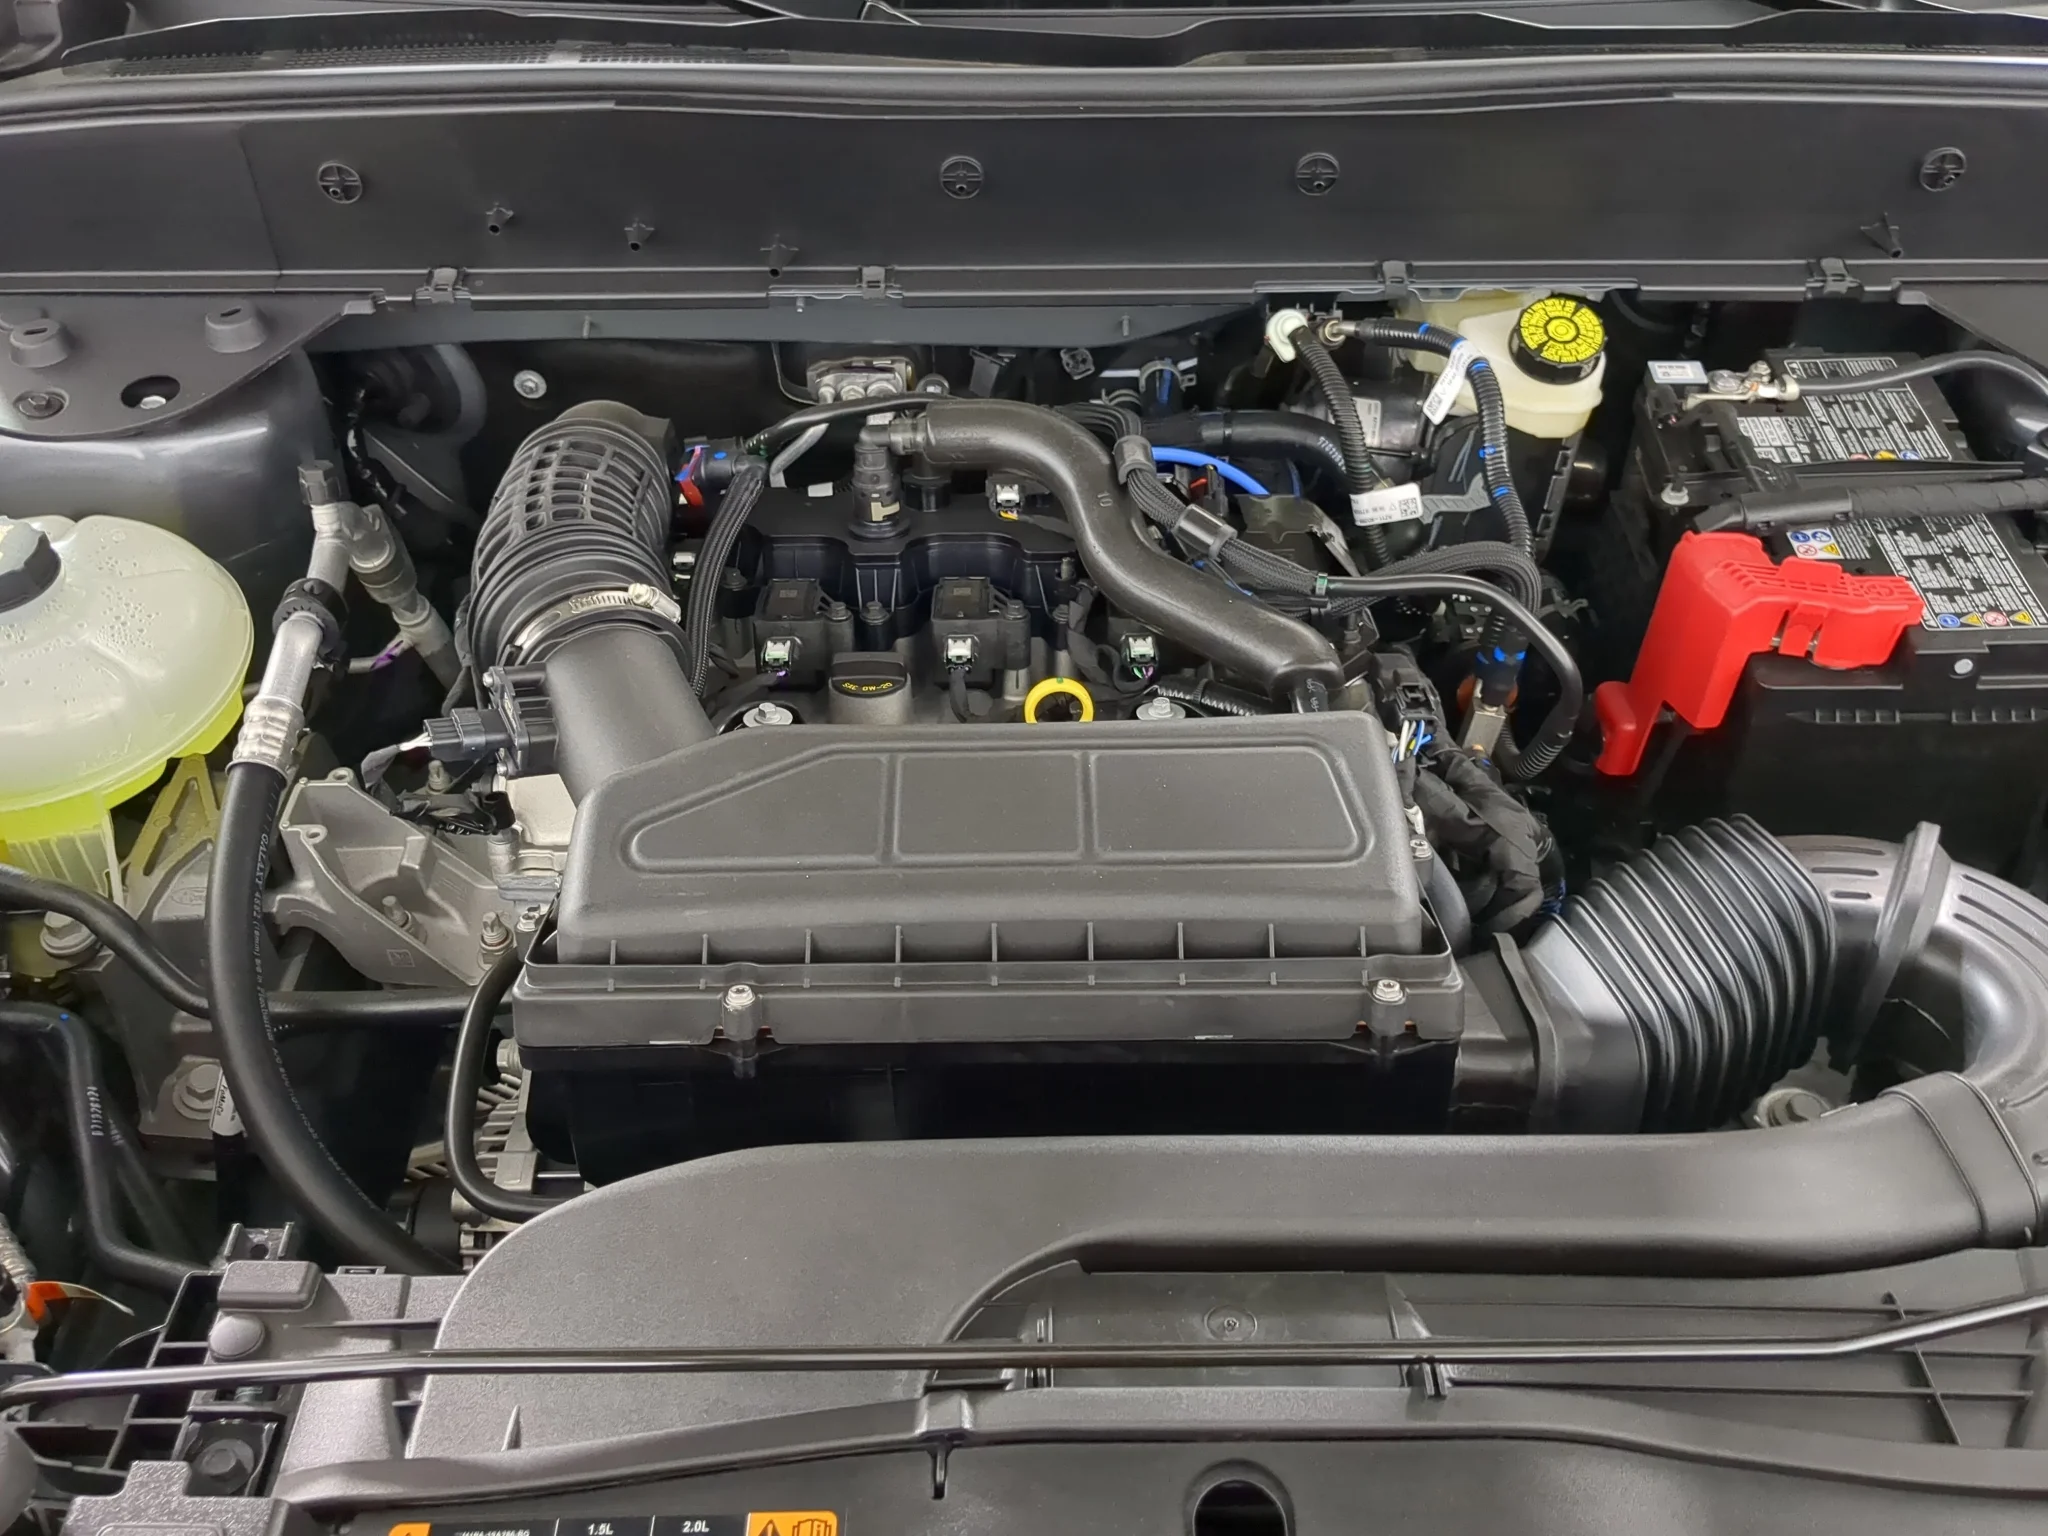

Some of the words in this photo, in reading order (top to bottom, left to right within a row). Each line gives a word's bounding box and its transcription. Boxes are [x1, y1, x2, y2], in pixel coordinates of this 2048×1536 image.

[842, 682, 858, 691] SAE
[255, 833, 269, 890] GALAXY
[587, 1522, 614, 1536] 1.5L
[683, 1520, 710, 1533] 2.0L
